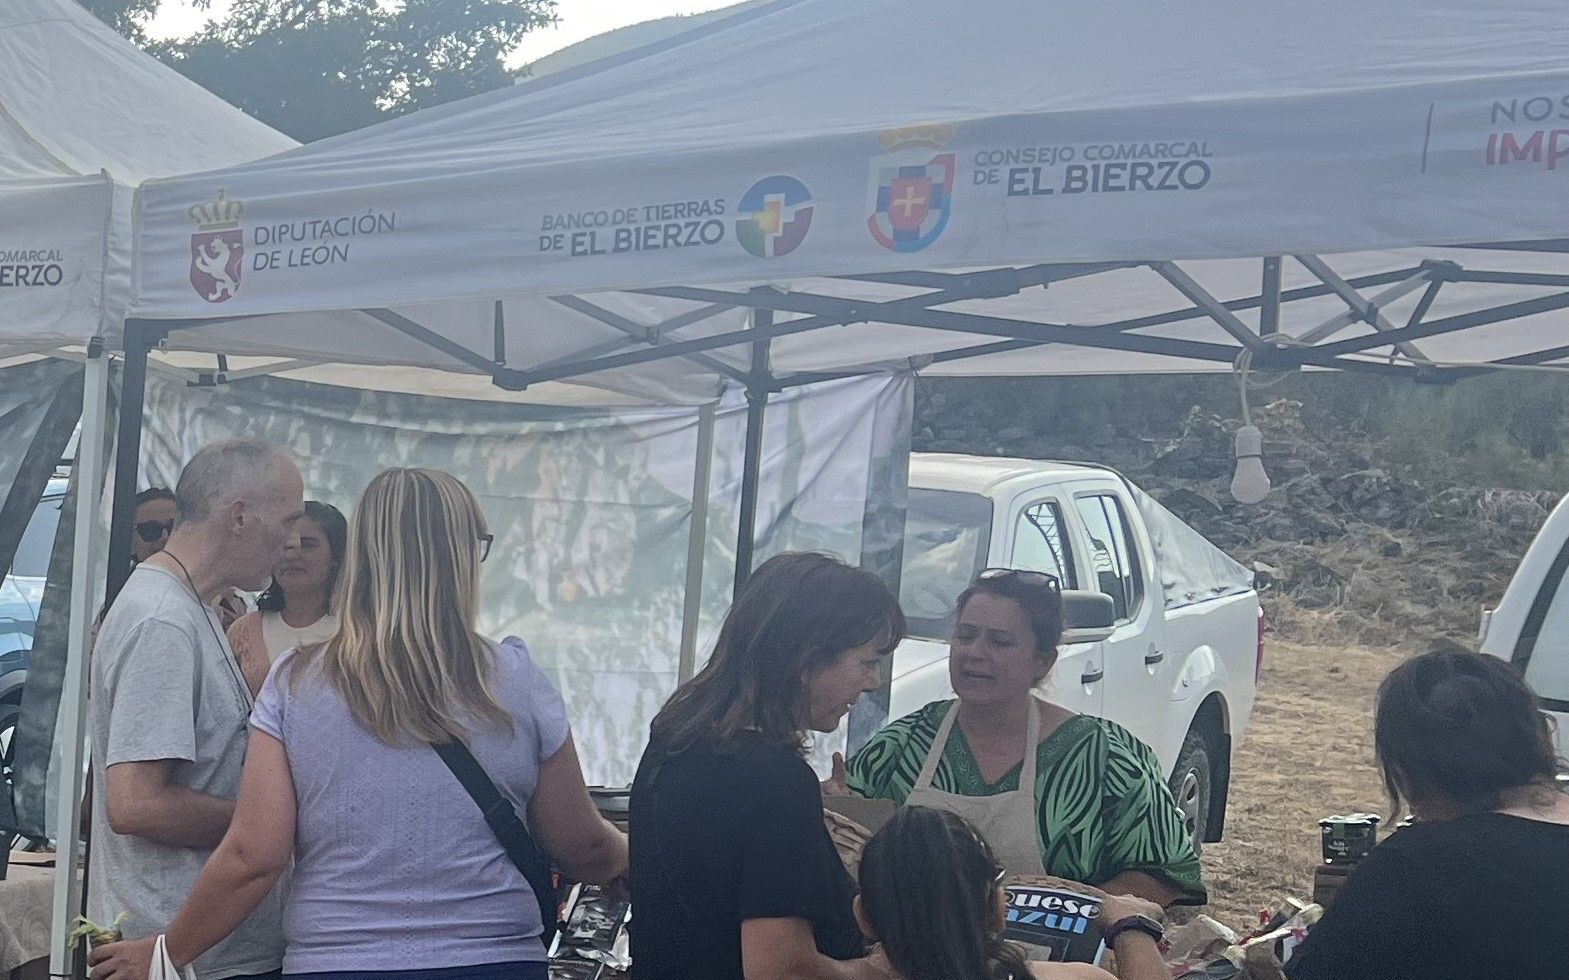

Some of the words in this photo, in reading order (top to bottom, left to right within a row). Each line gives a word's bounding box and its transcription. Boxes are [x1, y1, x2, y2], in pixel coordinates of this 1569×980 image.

[973, 146, 1076, 168] CONSEJO
[1083, 141, 1214, 161] COMARCAL
[972, 168, 1000, 186] DE
[1006, 166, 1055, 197] EL
[1061, 159, 1212, 195] BIERZO
[254, 208, 396, 246] DIPUTACIÓN
[540, 210, 609, 232] BANCO
[611, 207, 639, 226] DE
[642, 198, 725, 223] TIERRAS
[253, 250, 282, 271] DE
[287, 240, 350, 268] LEÓN
[539, 234, 565, 251] DE
[570, 230, 607, 257] EL
[612, 218, 725, 255] BIERZO
